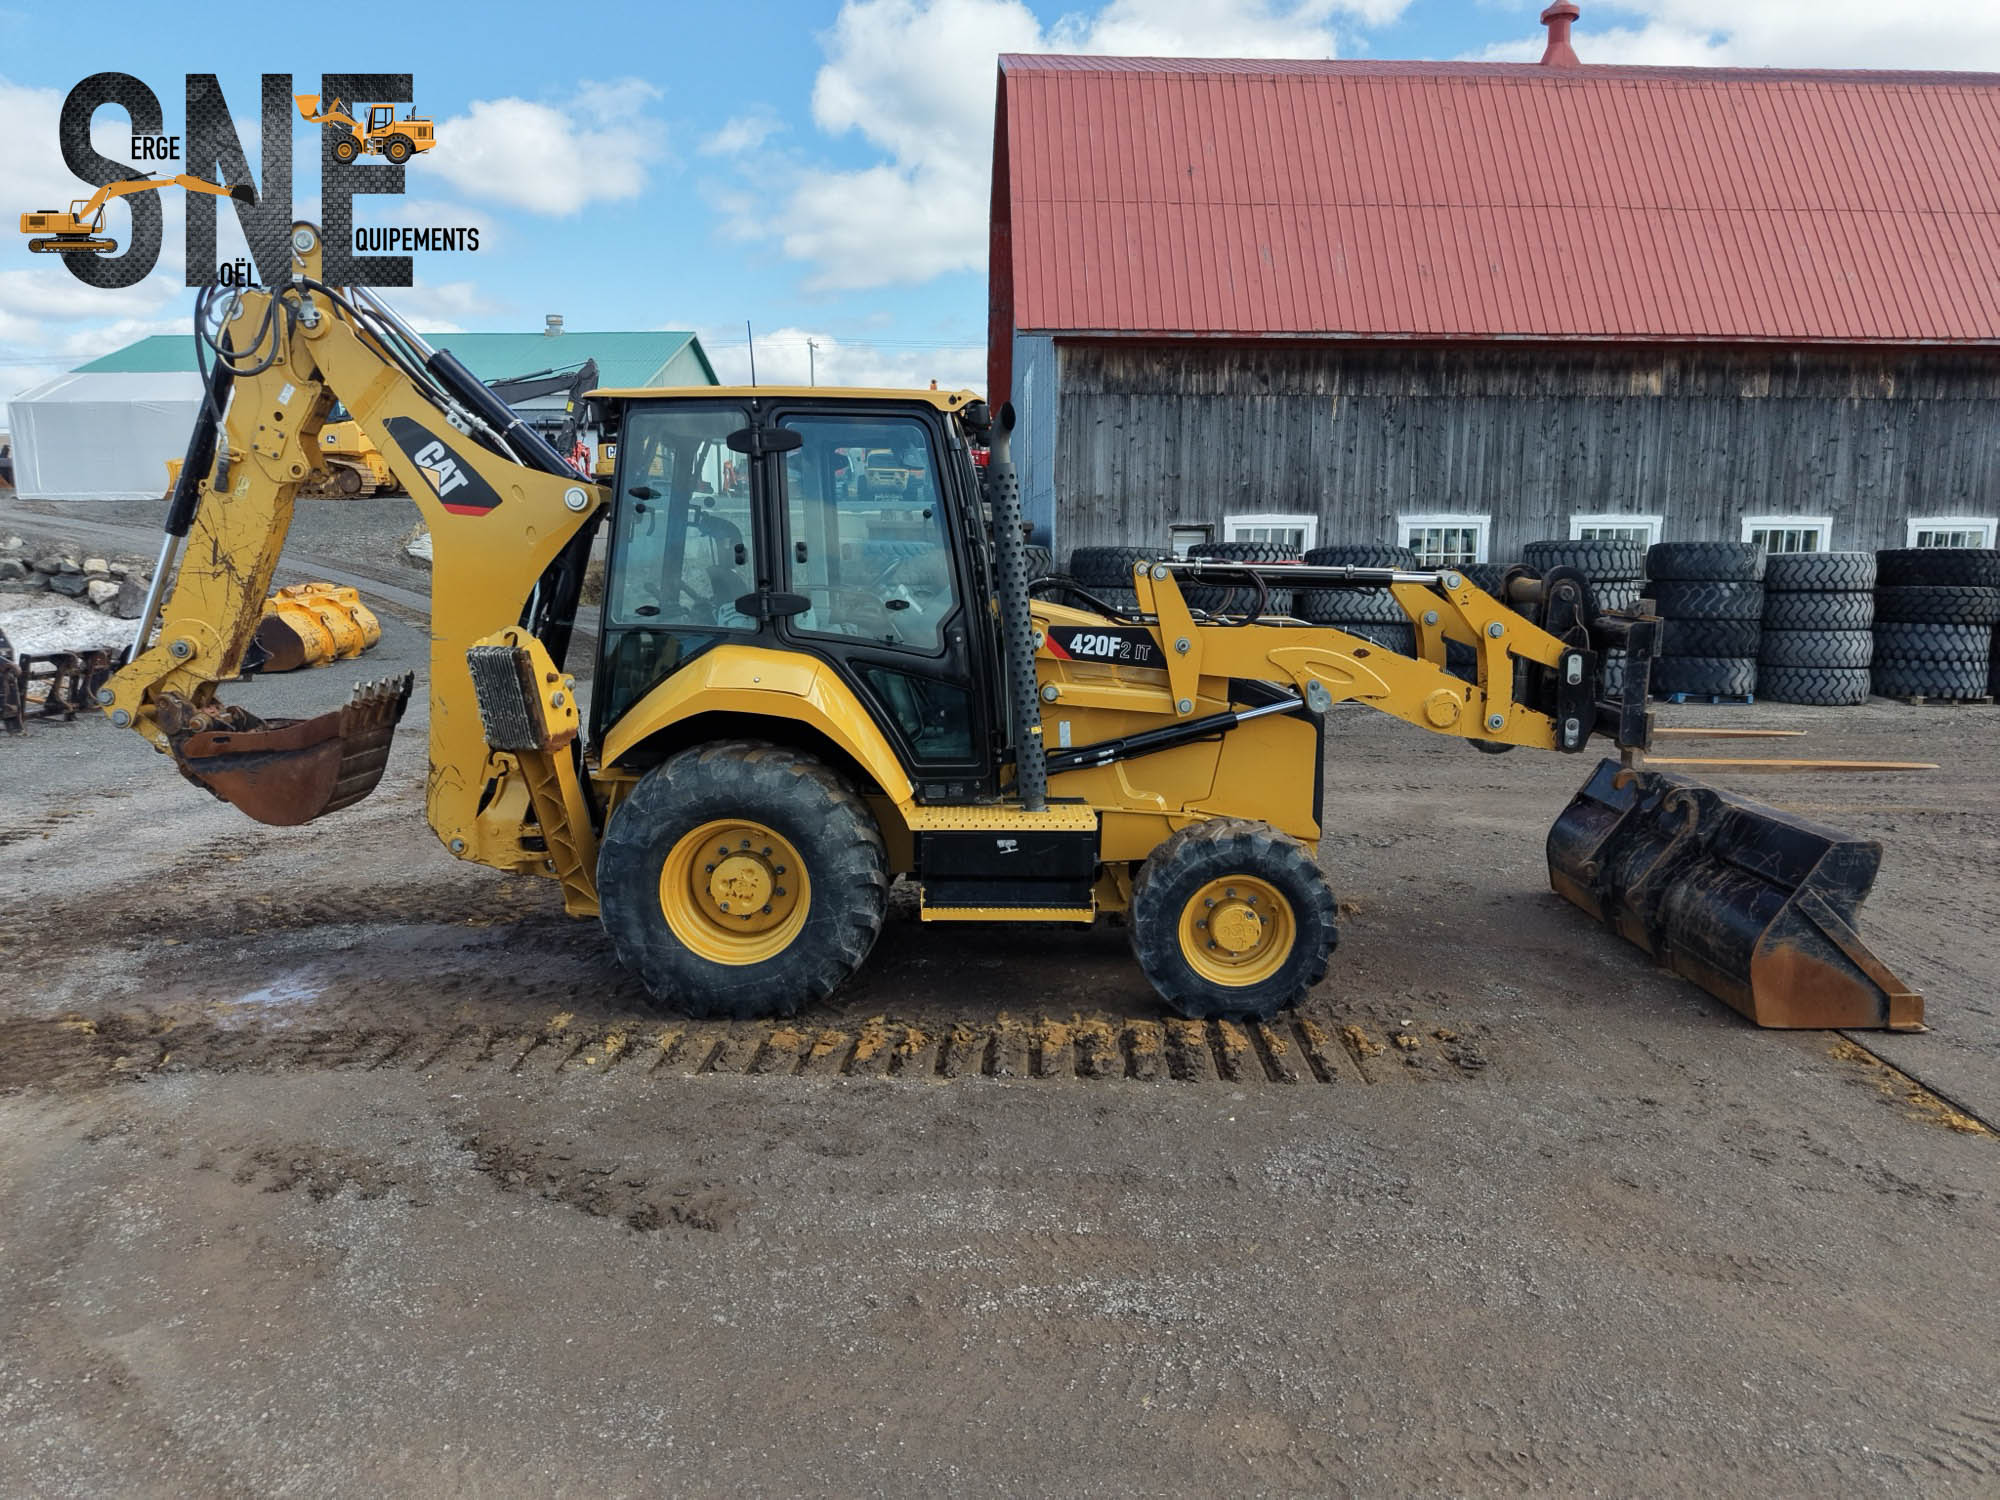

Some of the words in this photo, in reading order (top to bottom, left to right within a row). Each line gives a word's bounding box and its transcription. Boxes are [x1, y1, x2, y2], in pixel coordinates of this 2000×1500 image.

[415, 440, 469, 497] CAT
[1070, 633, 1131, 659] 420F2
[1135, 645, 1151, 661] IT
